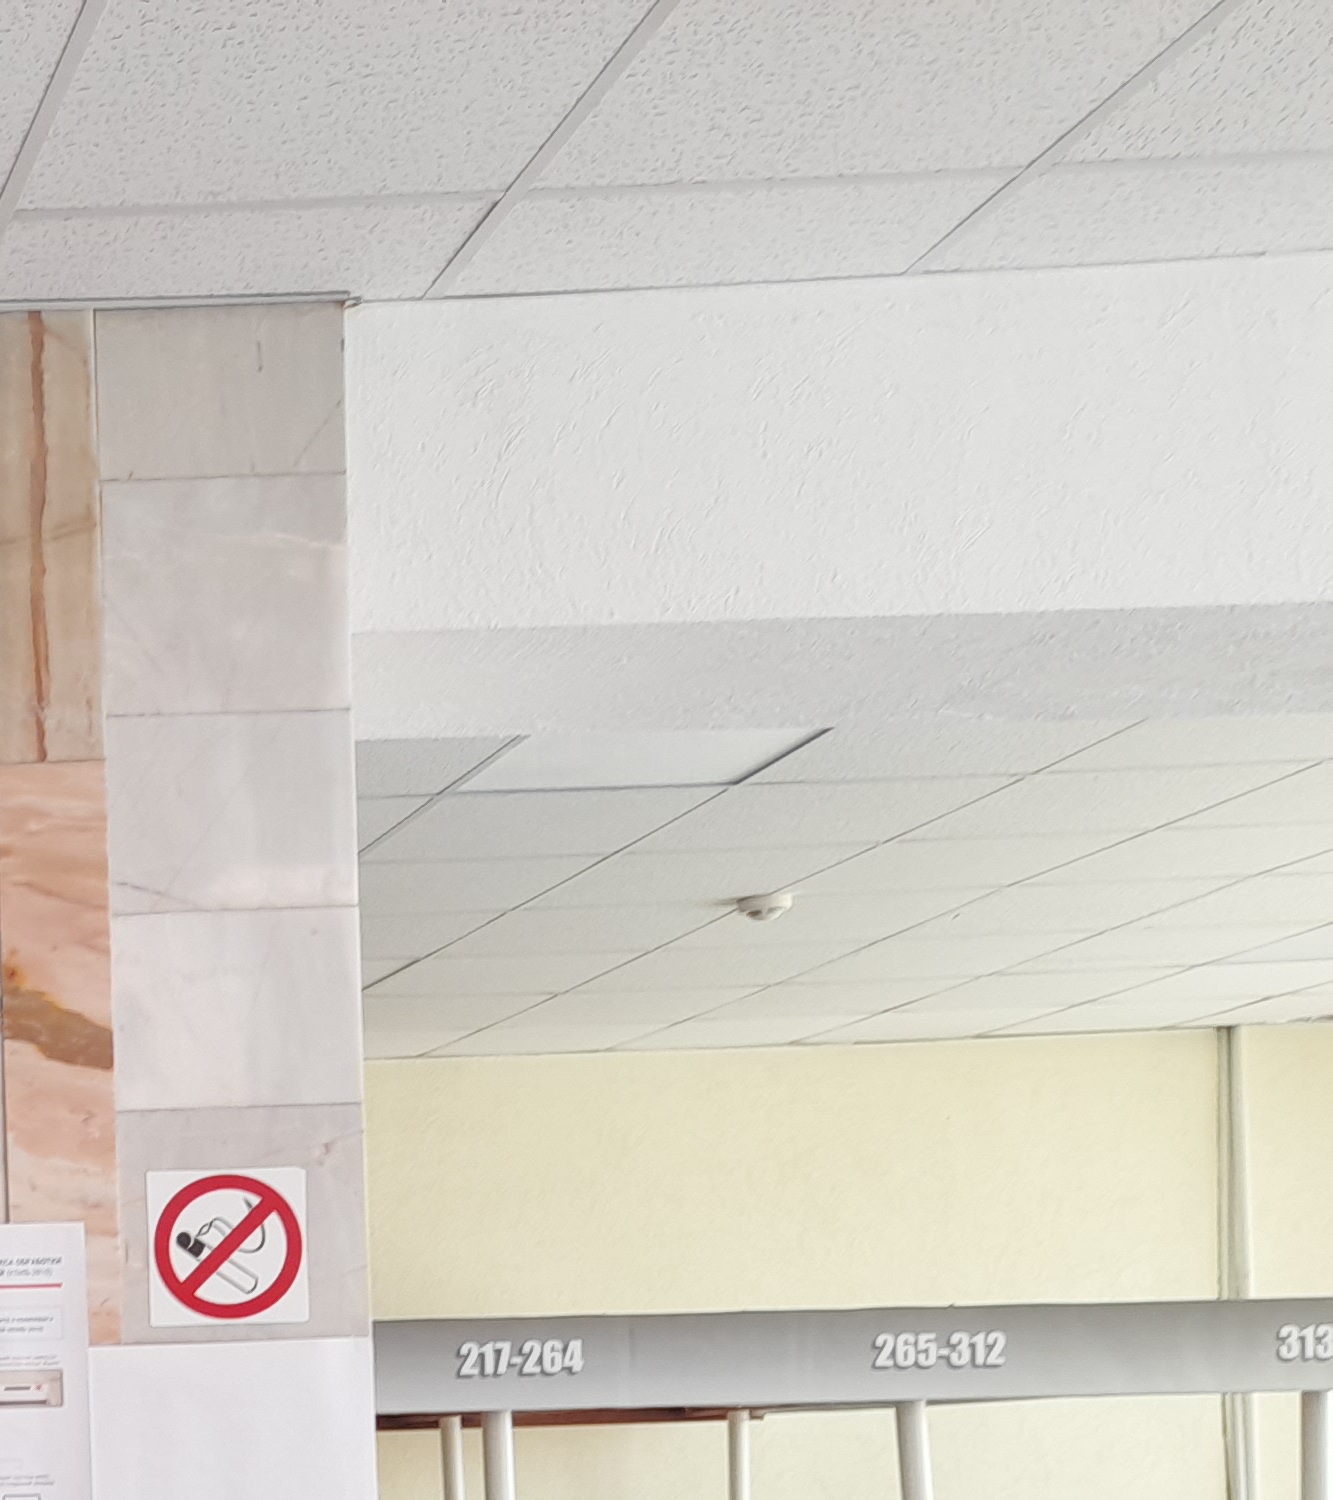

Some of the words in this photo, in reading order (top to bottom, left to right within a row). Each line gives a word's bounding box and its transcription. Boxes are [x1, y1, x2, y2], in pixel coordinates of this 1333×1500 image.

[457, 1338, 585, 1377] 217-264
[873, 1329, 1008, 1368] 265-312
[1277, 1322, 1333, 1361] 313
